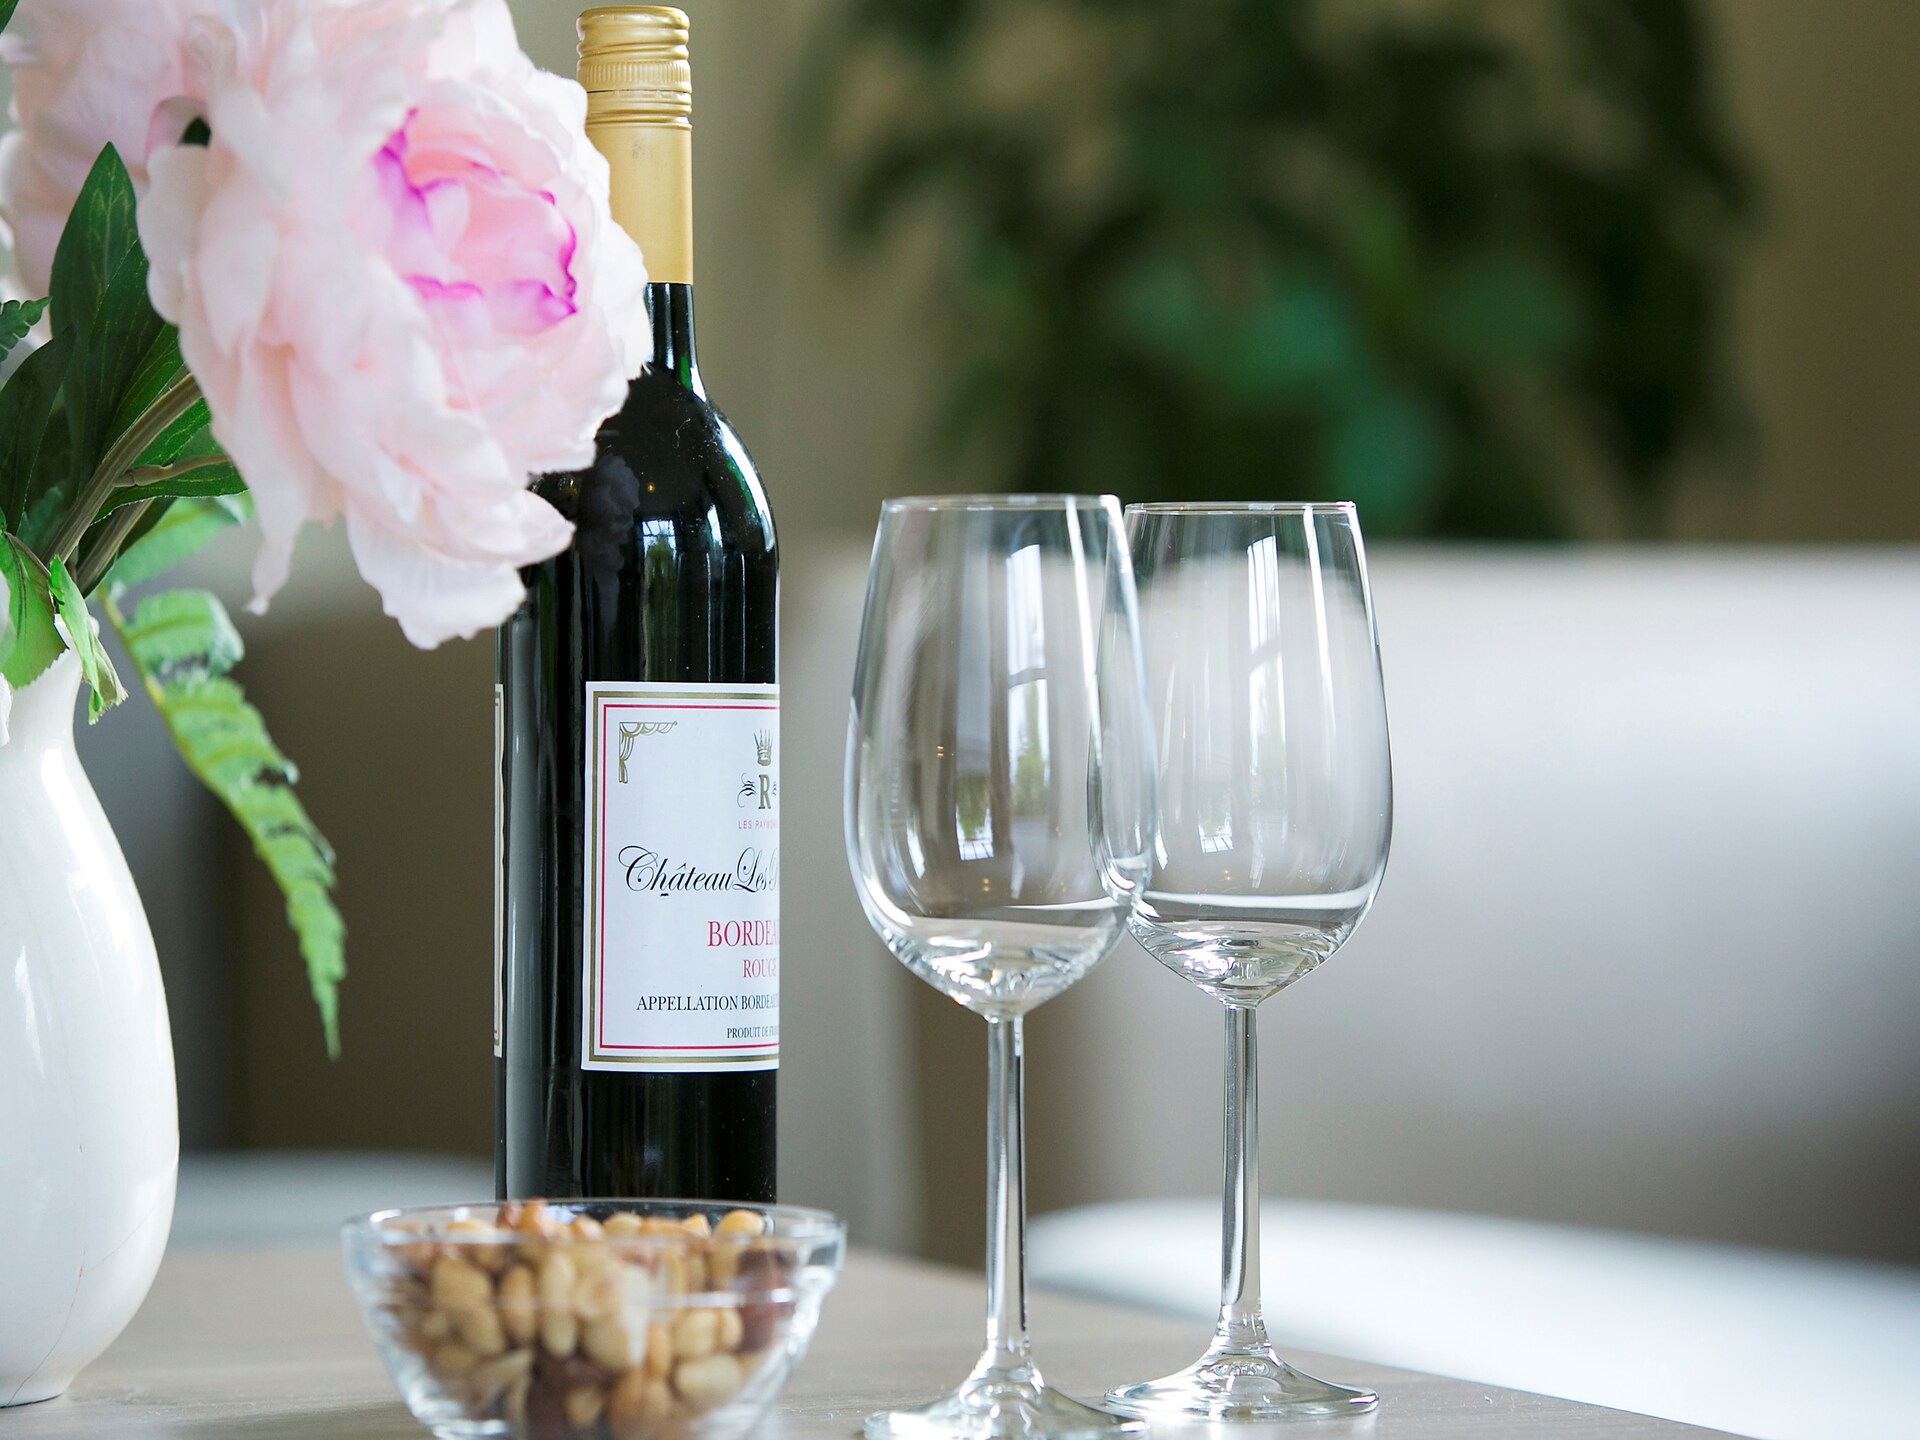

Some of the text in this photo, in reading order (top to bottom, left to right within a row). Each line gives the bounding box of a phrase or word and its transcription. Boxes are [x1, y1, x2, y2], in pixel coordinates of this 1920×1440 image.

[758, 774, 771, 810] R
[738, 820, 753, 830] LES
[618, 845, 733, 892] Château
[732, 847, 767, 893] Les
[636, 995, 739, 1011] APPELLATION
[727, 1026, 761, 1039] PRODUIT
